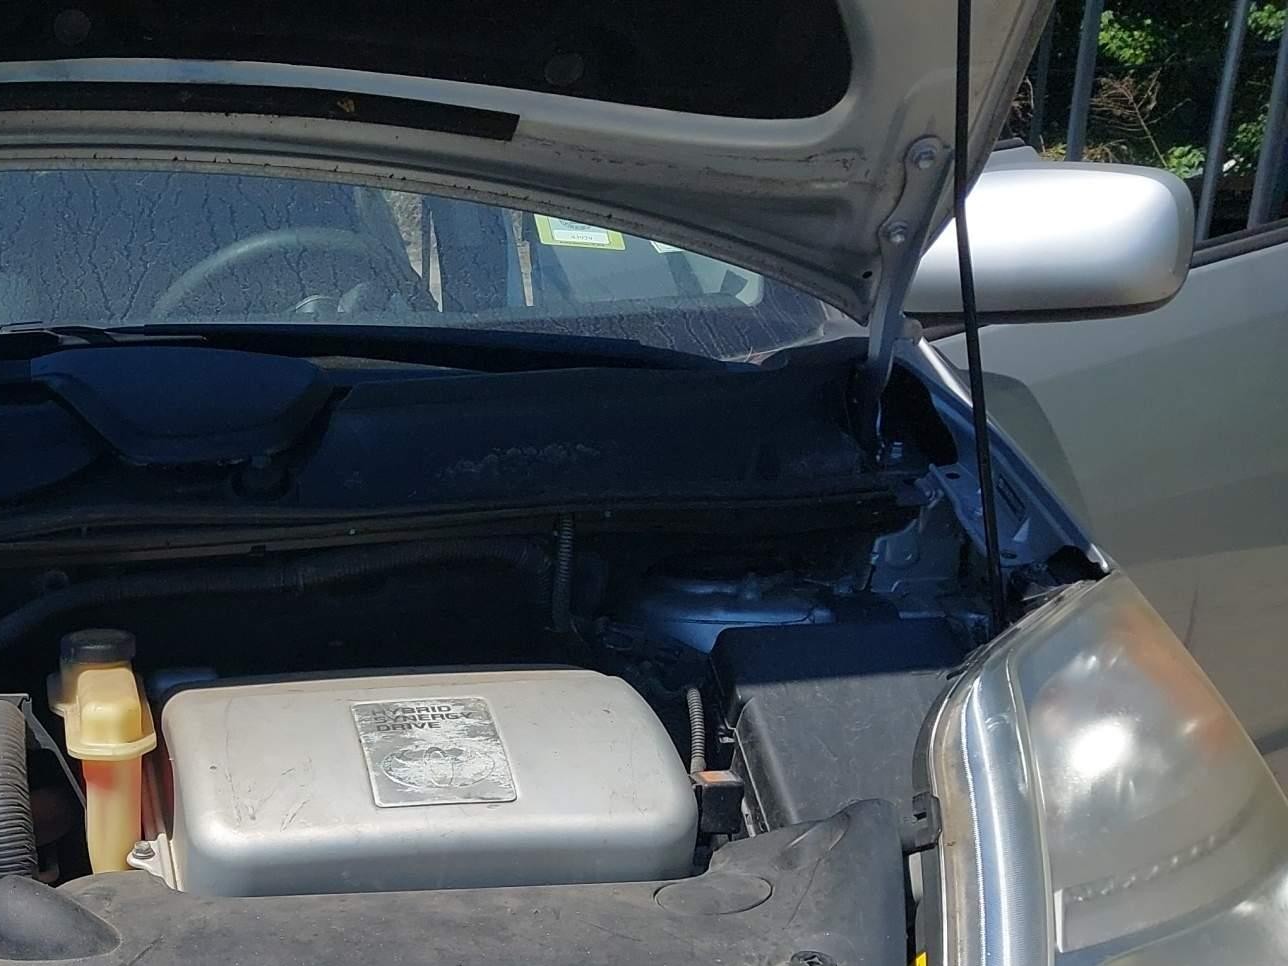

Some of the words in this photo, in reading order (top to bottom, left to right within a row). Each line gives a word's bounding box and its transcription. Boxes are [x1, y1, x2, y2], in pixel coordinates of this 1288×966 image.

[372, 705, 452, 717] HYBRID
[374, 711, 473, 724] SYNERGY
[376, 721, 442, 732] DRIVE
